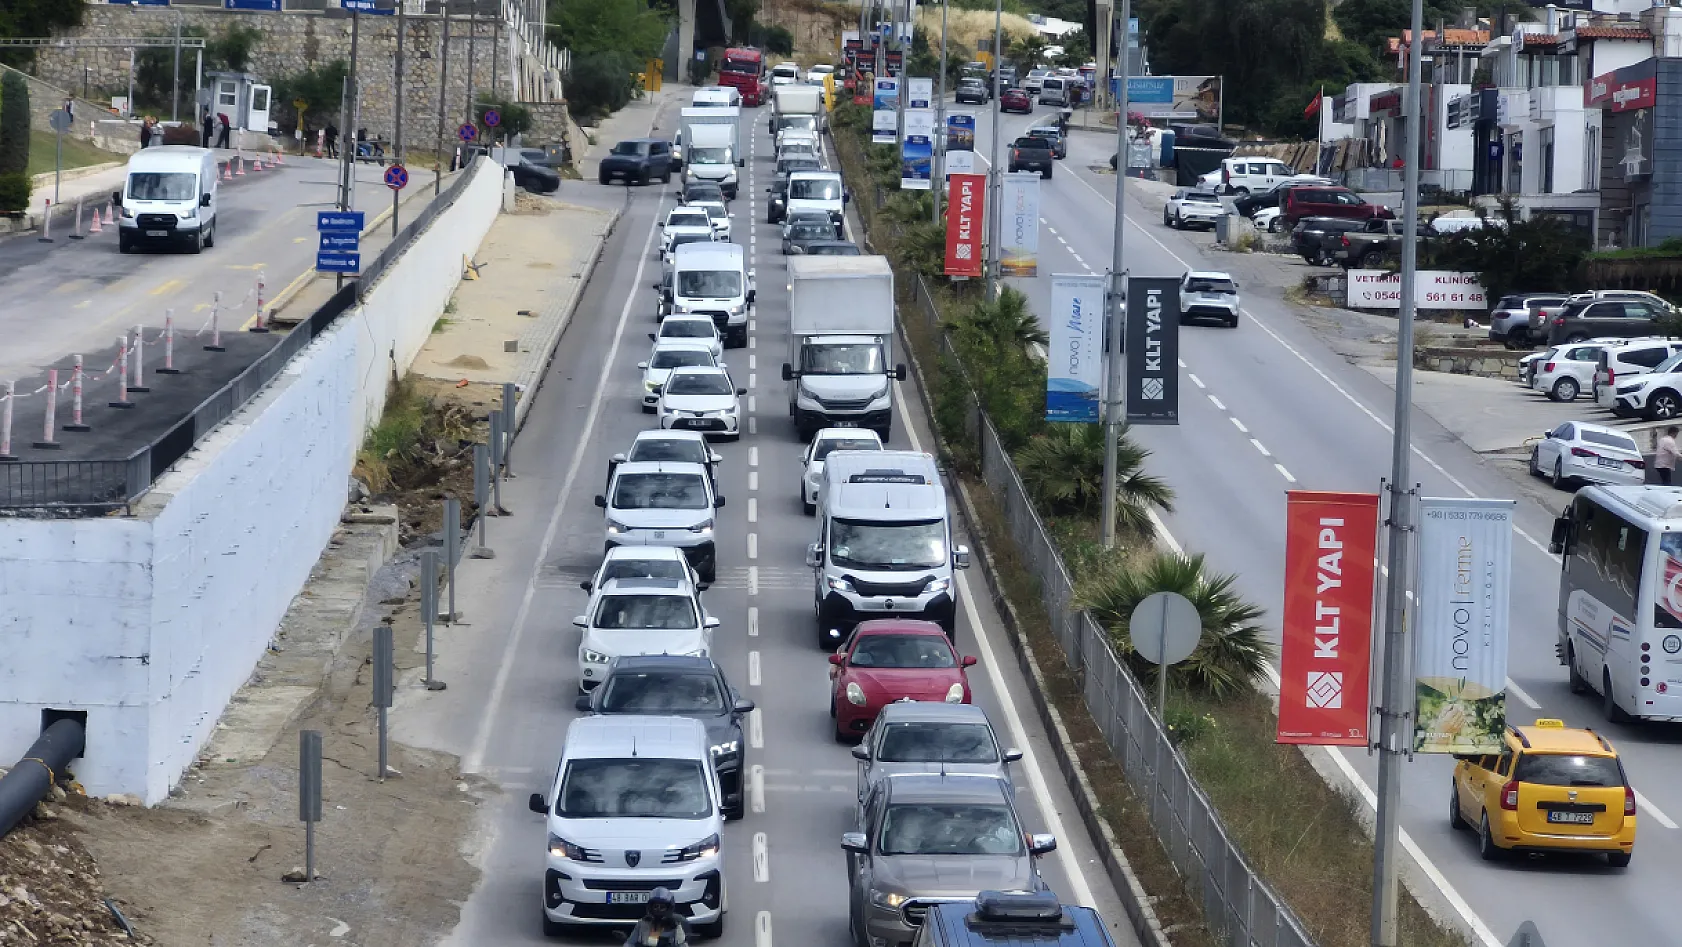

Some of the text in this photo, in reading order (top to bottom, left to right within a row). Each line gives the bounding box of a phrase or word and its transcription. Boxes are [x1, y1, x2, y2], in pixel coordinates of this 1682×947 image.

[960, 181, 973, 212] YAPI
[959, 215, 972, 240] KLT
[1426, 292, 1446, 302] 561
[1451, 293, 1463, 302] 61
[1145, 289, 1162, 371] KLT YAPI
[1313, 517, 1345, 659] KLT YAPI
[1452, 608, 1471, 671] novo
